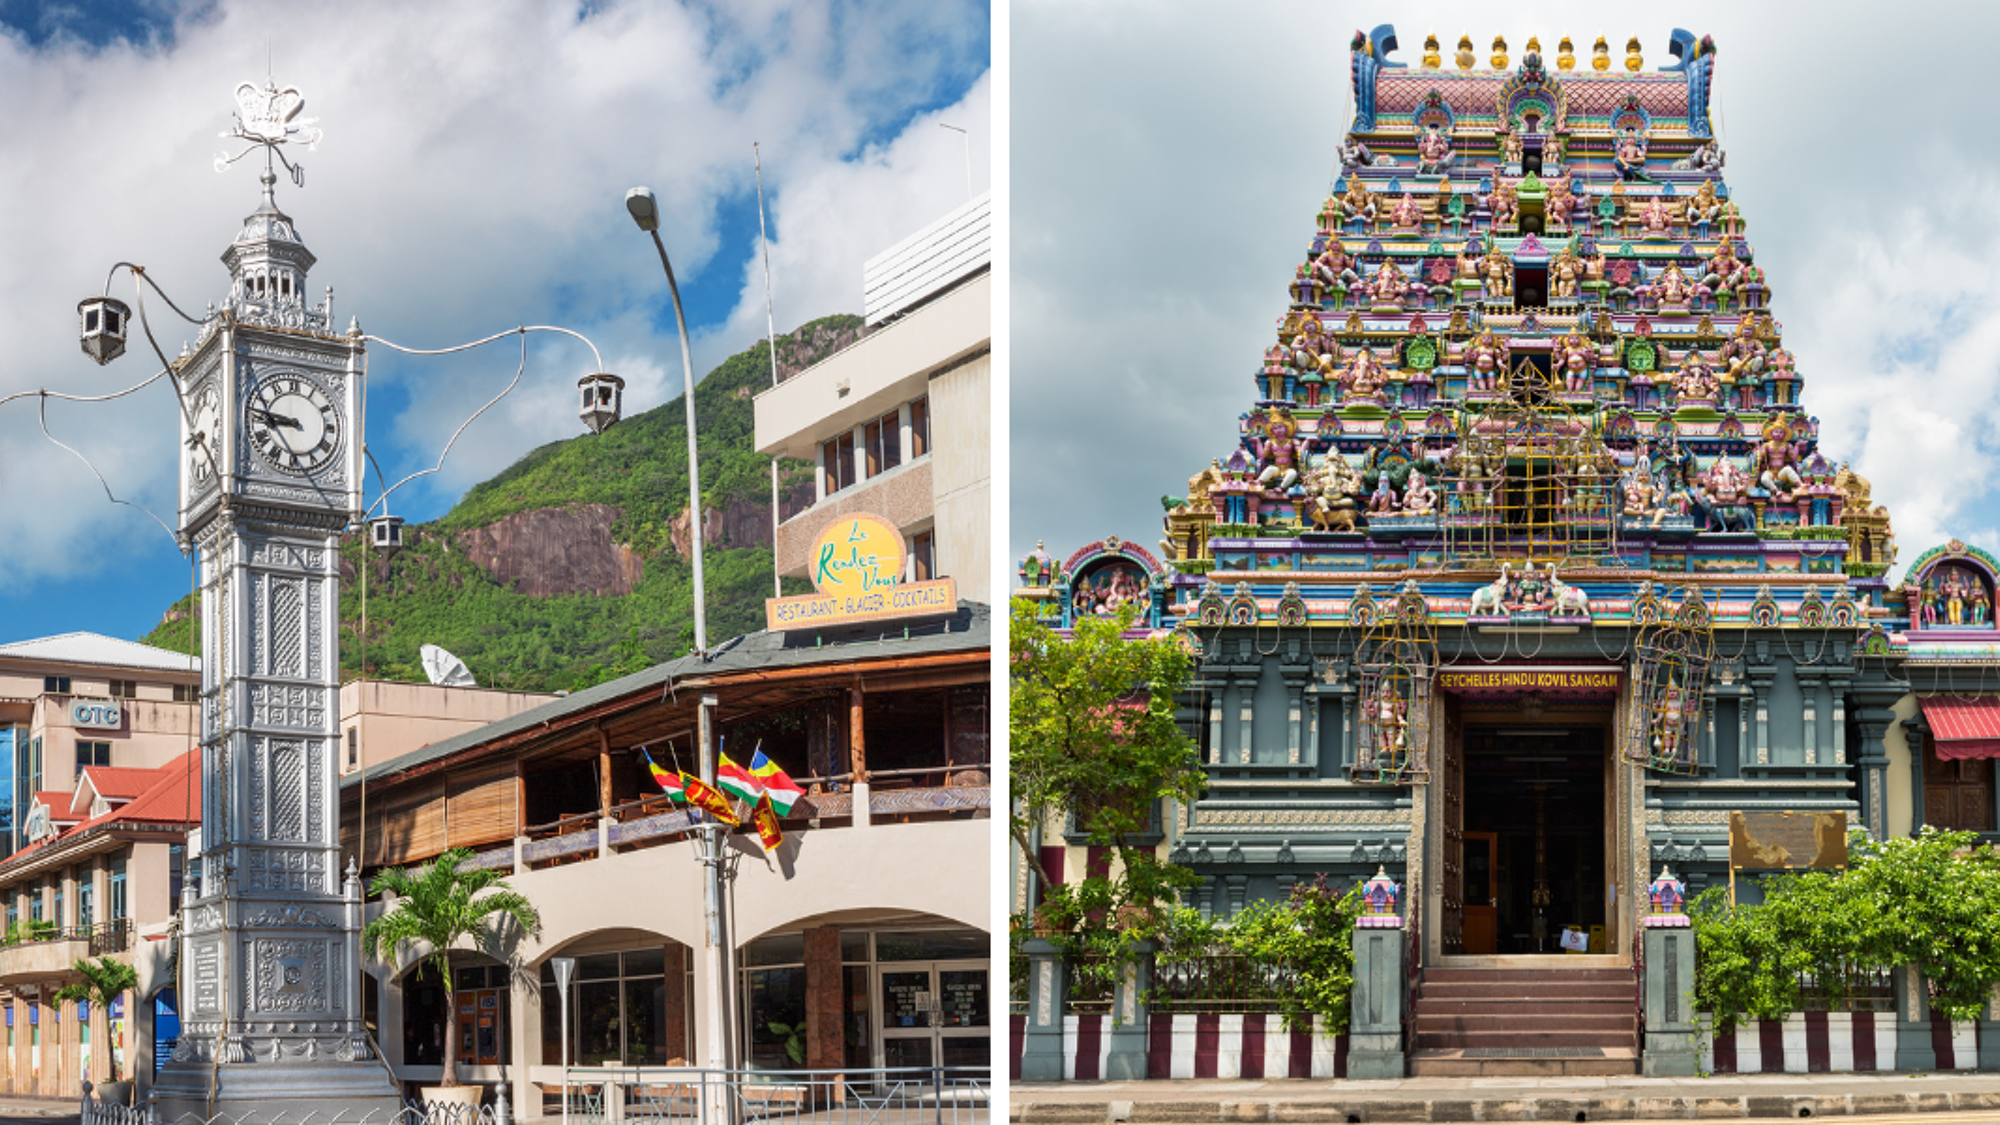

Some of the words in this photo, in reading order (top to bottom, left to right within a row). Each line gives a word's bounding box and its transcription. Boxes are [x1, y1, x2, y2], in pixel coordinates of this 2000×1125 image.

[848, 521, 868, 542] Le
[817, 543, 879, 584] Rendez
[863, 565, 897, 593] Vous
[777, 599, 838, 621] RESTAURANT
[846, 594, 884, 613] GLACIER
[893, 587, 945, 608] COCKTAILS
[1440, 674, 1500, 687] SEYCHELLES
[1502, 673, 1535, 686] HINDU
[1538, 673, 1568, 687] KOVIL
[1570, 674, 1617, 687] SANGAM
[75, 705, 118, 725] OTC
